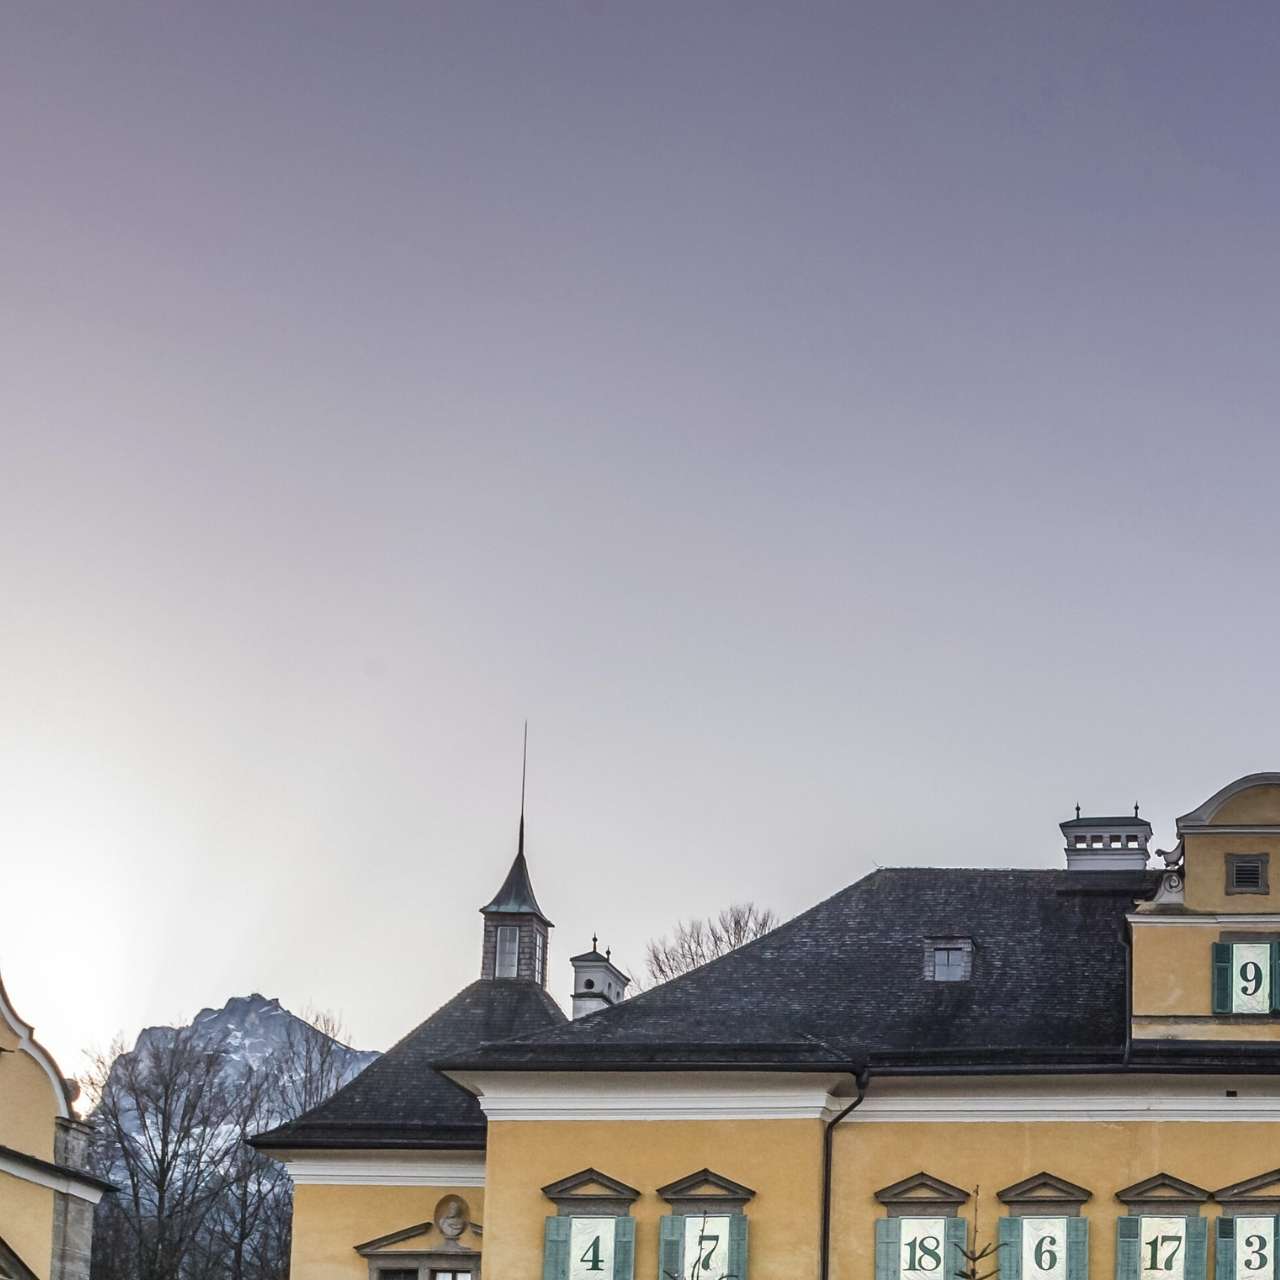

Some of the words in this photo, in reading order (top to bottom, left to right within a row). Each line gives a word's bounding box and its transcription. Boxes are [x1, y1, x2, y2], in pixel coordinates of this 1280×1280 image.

[1240, 961, 1263, 996] 9
[580, 1235, 604, 1271] 4
[698, 1235, 719, 1271] 7
[903, 1236, 941, 1271] 18
[1034, 1235, 1057, 1271] 6
[1144, 1235, 1182, 1271] 17
[1244, 1235, 1268, 1271] 3
